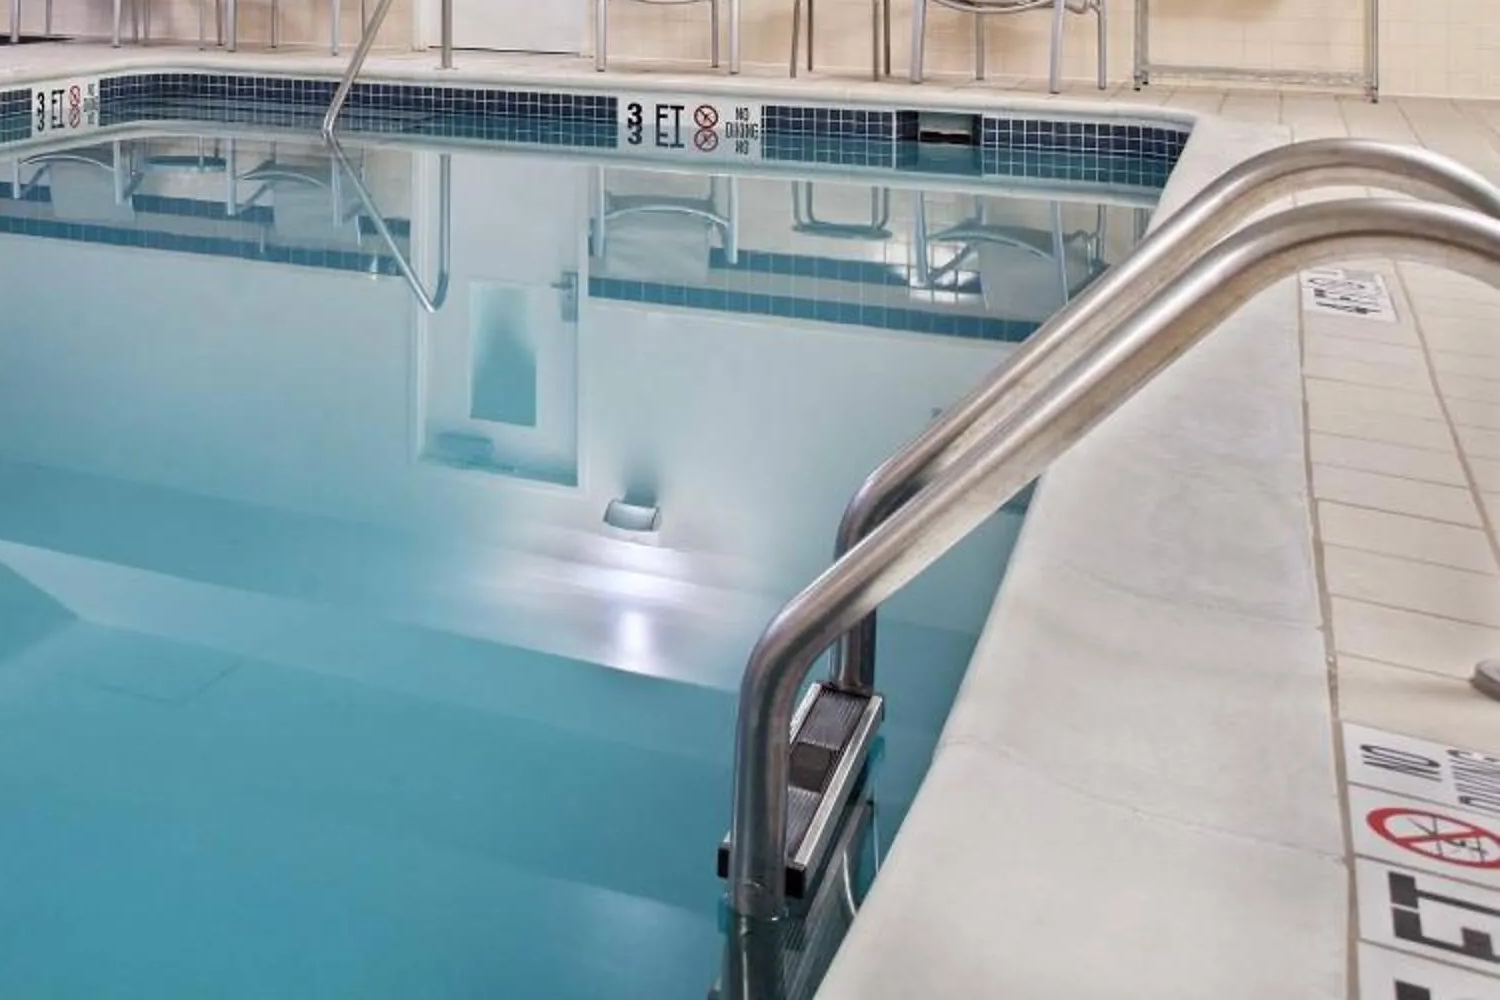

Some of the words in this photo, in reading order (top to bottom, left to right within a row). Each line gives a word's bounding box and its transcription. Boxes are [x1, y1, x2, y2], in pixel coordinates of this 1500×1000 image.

[627, 103, 643, 126] 3
[655, 104, 685, 126] FT
[1359, 744, 1443, 782] NO
[1387, 871, 1500, 964] FT
